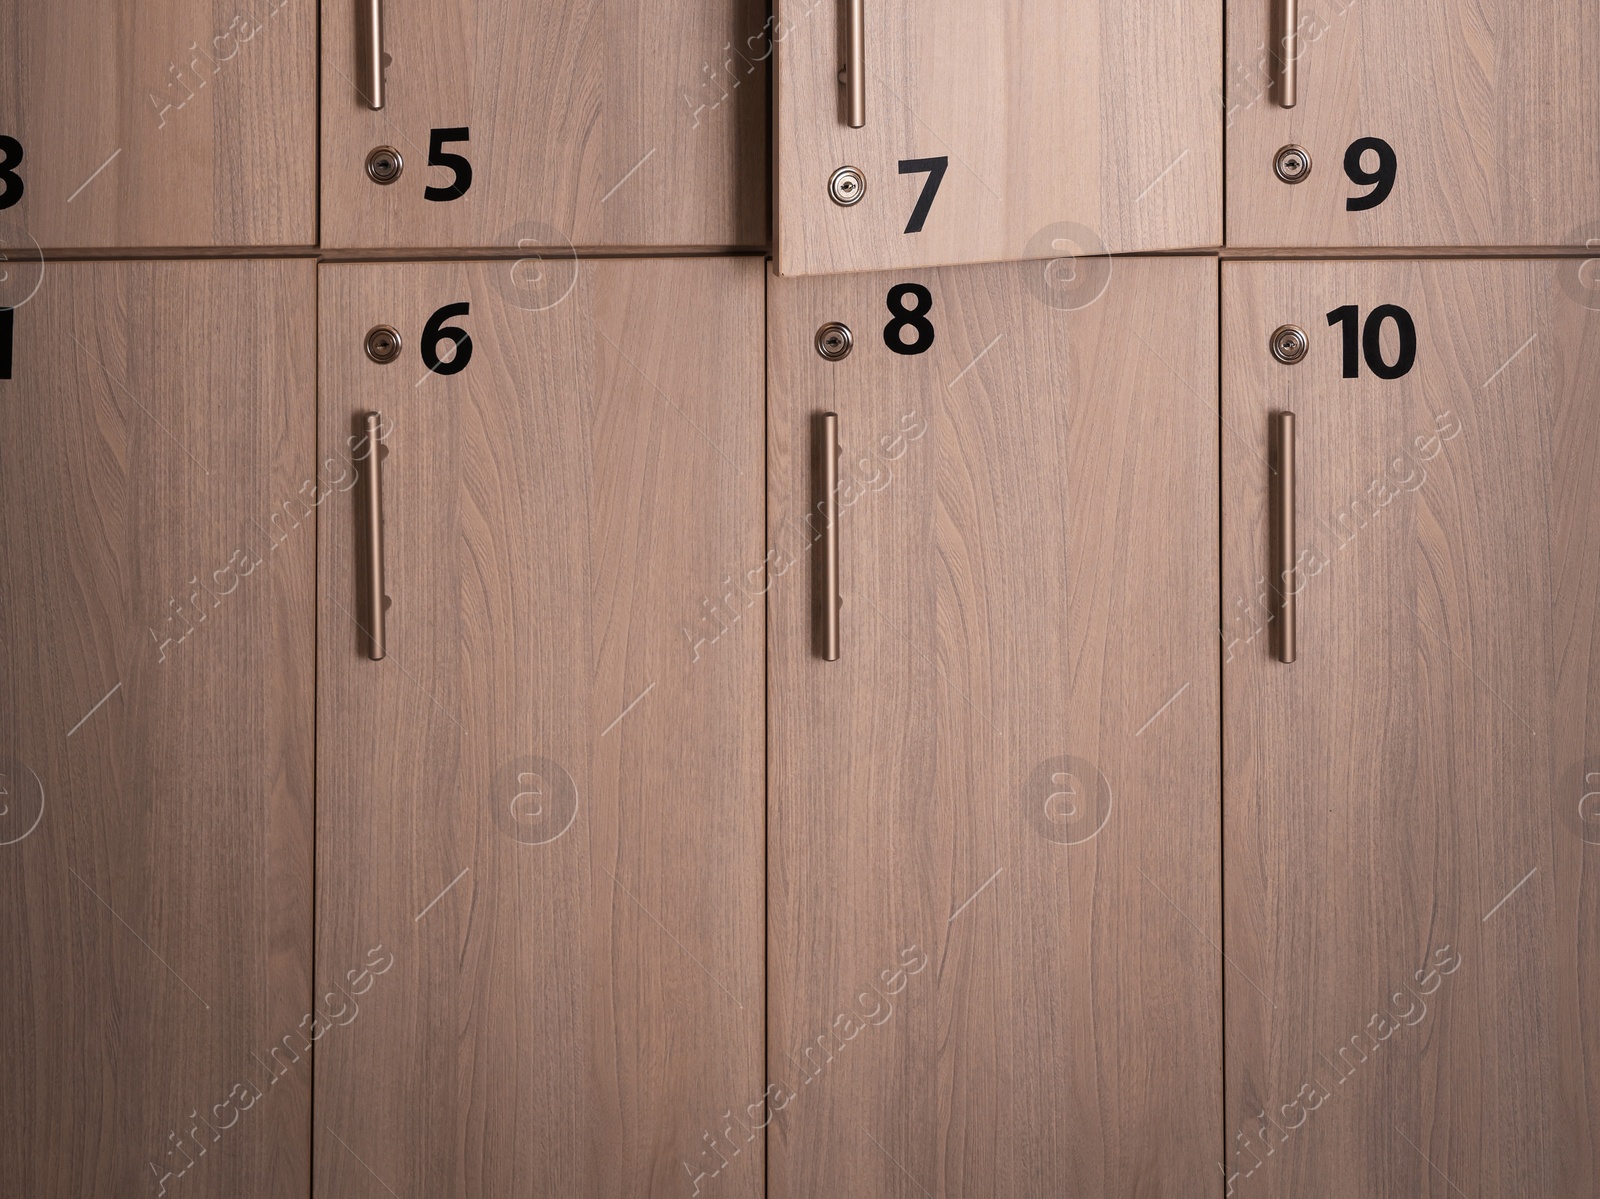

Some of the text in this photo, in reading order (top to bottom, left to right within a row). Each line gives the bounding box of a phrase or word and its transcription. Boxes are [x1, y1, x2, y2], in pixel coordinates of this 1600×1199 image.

[423, 126, 473, 202] 5
[897, 156, 948, 234] 7
[1343, 136, 1398, 212] 9
[420, 302, 473, 376] 6
[882, 282, 935, 356] 8
[1326, 303, 1417, 380] 10
